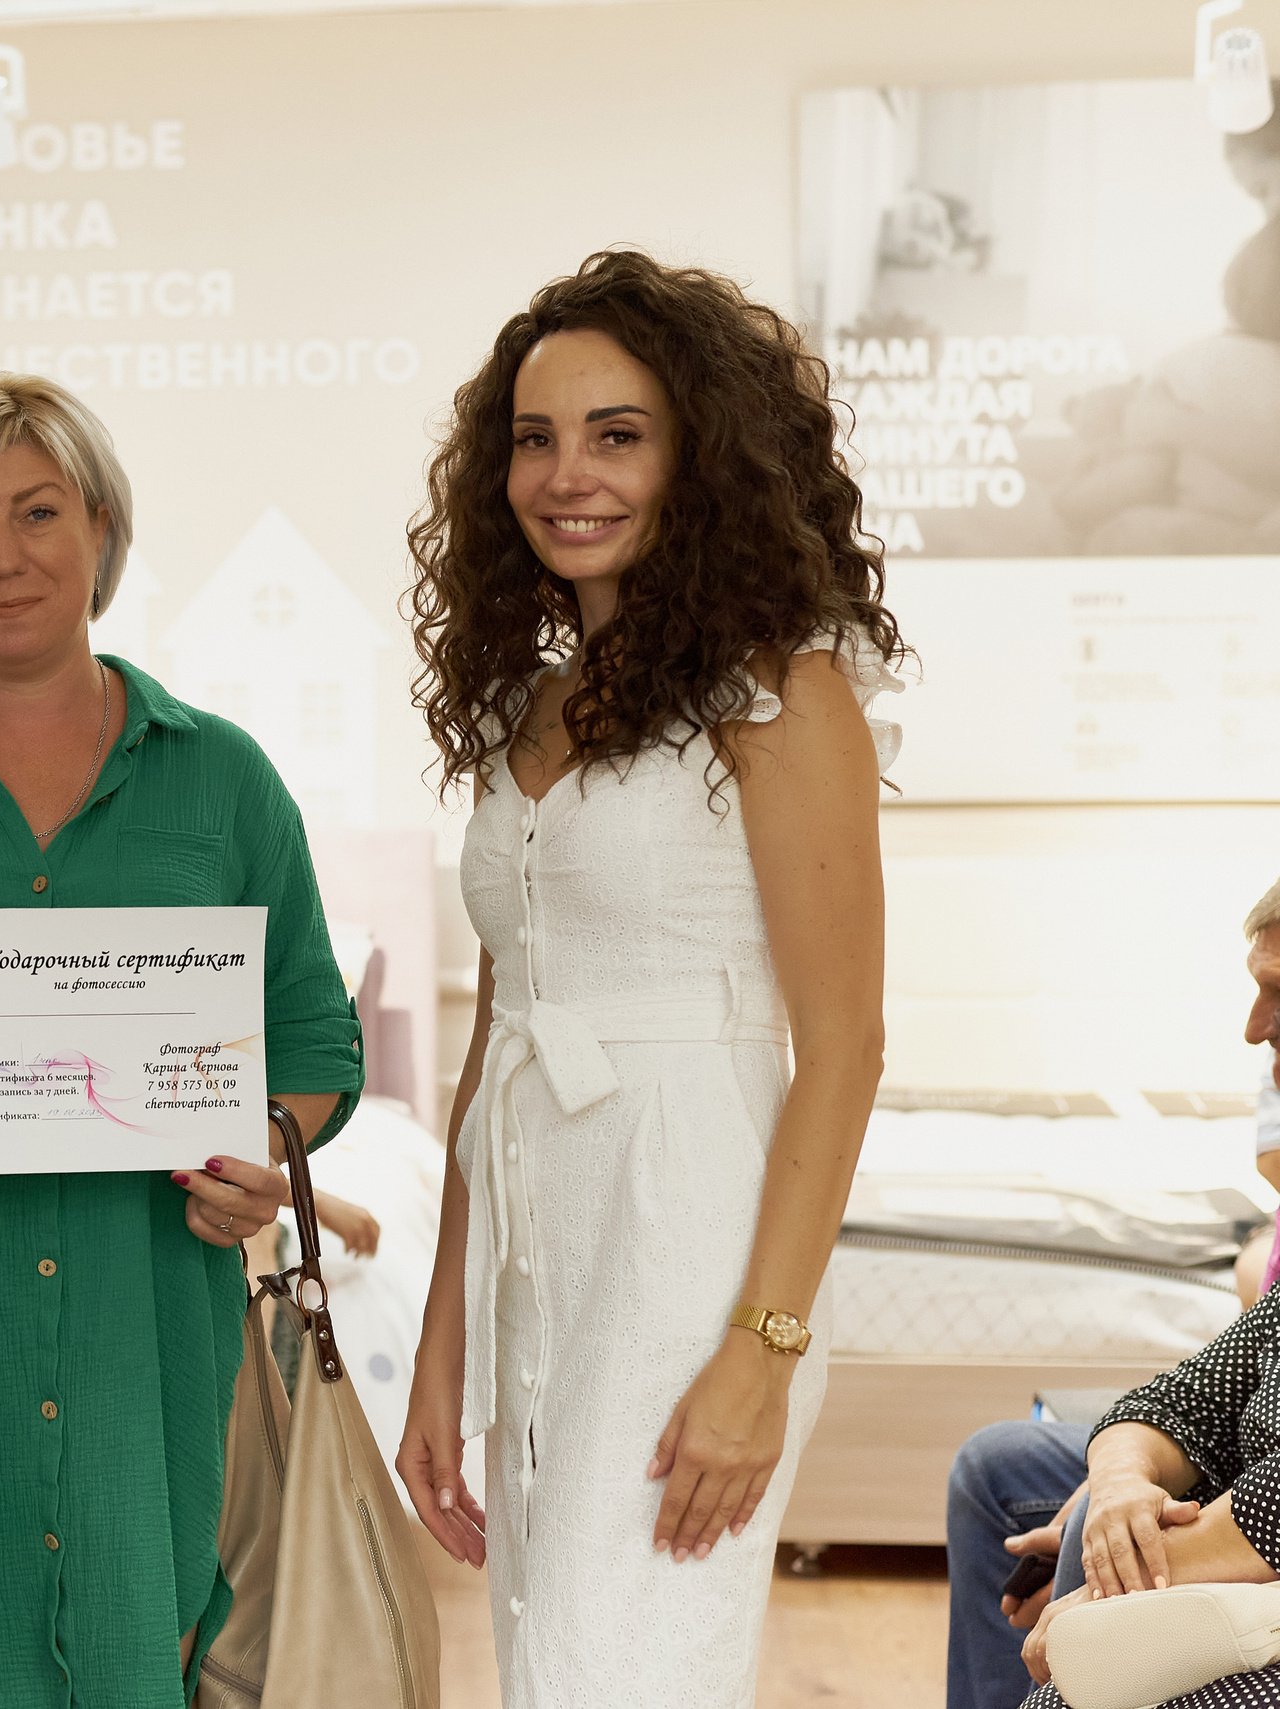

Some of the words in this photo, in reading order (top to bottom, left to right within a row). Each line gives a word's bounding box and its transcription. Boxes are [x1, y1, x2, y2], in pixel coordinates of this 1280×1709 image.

[824, 336, 930, 378] НАМ
[939, 334, 1130, 382] ДОРОГА
[856, 423, 1018, 466] ИНУТА
[860, 467, 1026, 509] АШЕГО
[864, 511, 926, 553] НА
[116, 946, 246, 974] сертификат
[53, 981, 69, 990] на
[70, 976, 146, 993] фотосессию
[159, 1041, 222, 1057] Фотограф
[142, 1062, 187, 1076] Карина
[190, 1061, 239, 1075] Чернова
[47, 1072, 54, 1082] 6
[147, 1080, 155, 1091] 7
[157, 1080, 179, 1091] 958
[181, 1079, 203, 1091] 575
[205, 1079, 220, 1090] 05
[222, 1079, 237, 1090] 09
[0, 1089, 32, 1097] запись
[45, 1088, 52, 1098] 7
[53, 1086, 80, 1097] дней.
[144, 1096, 241, 1112] chernovaphoto.ru
